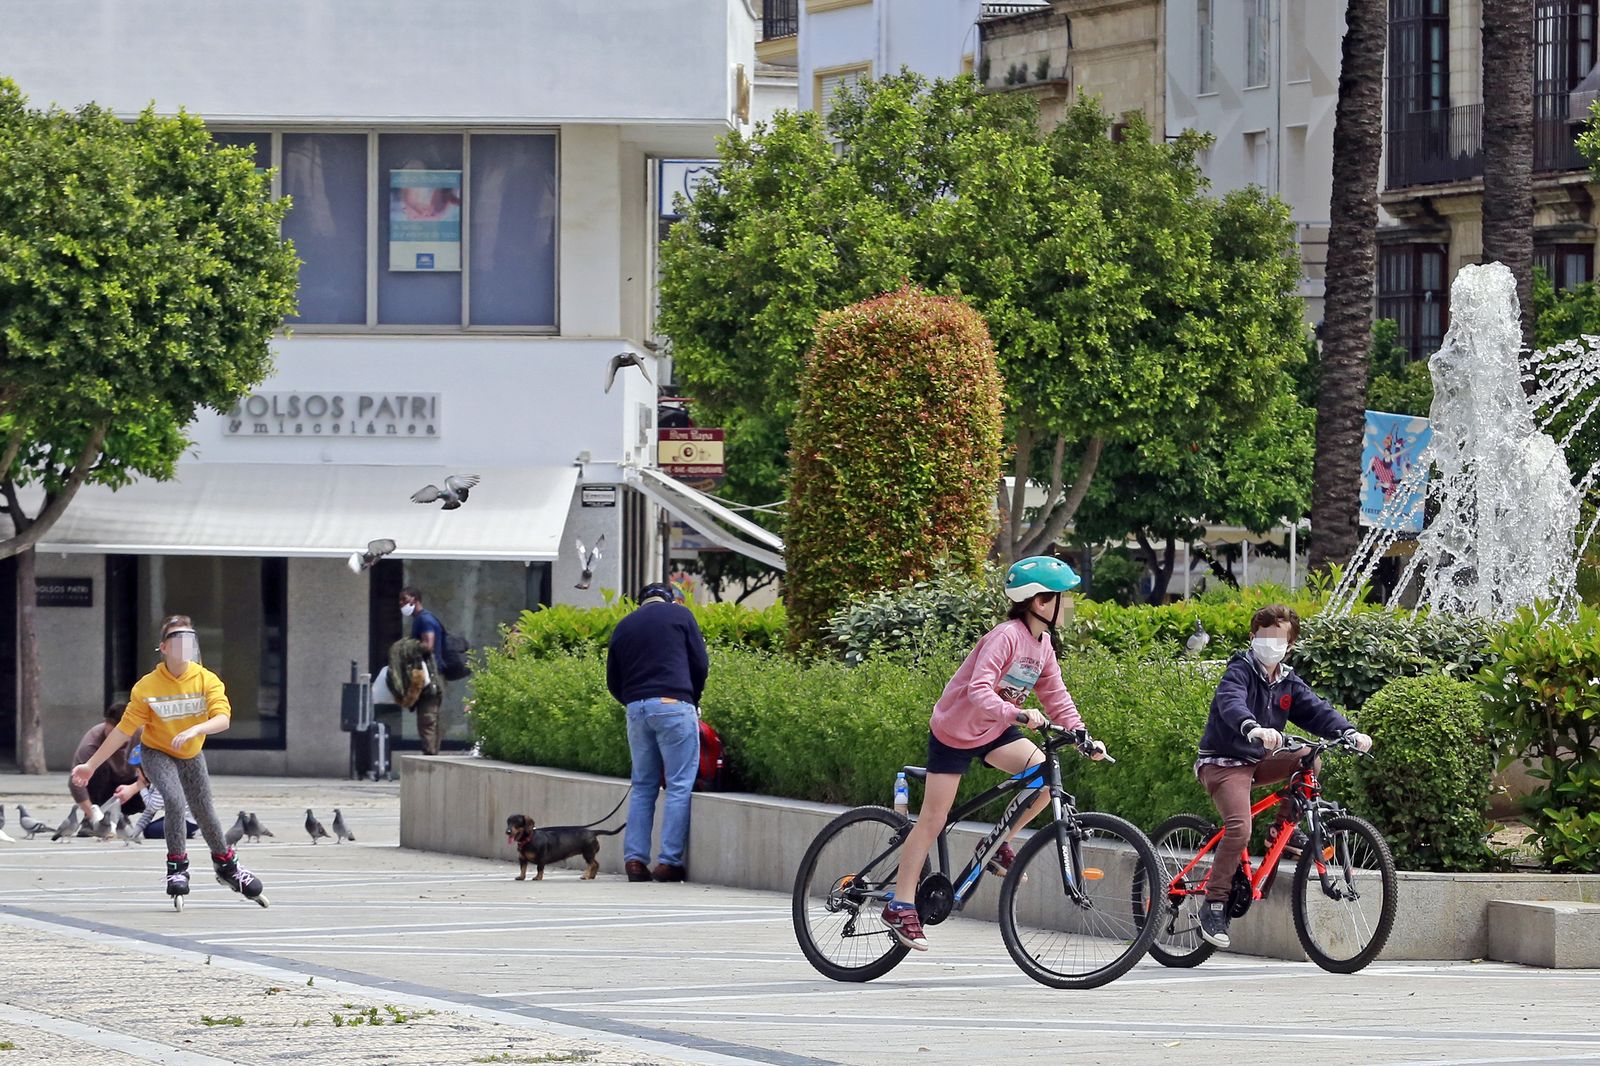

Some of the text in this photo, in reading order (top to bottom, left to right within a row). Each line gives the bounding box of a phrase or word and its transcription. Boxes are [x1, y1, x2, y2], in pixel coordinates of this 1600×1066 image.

[358, 395, 436, 419] PATRI
[253, 420, 436, 434] miscelánea
[37, 585, 65, 593] OLSOS
